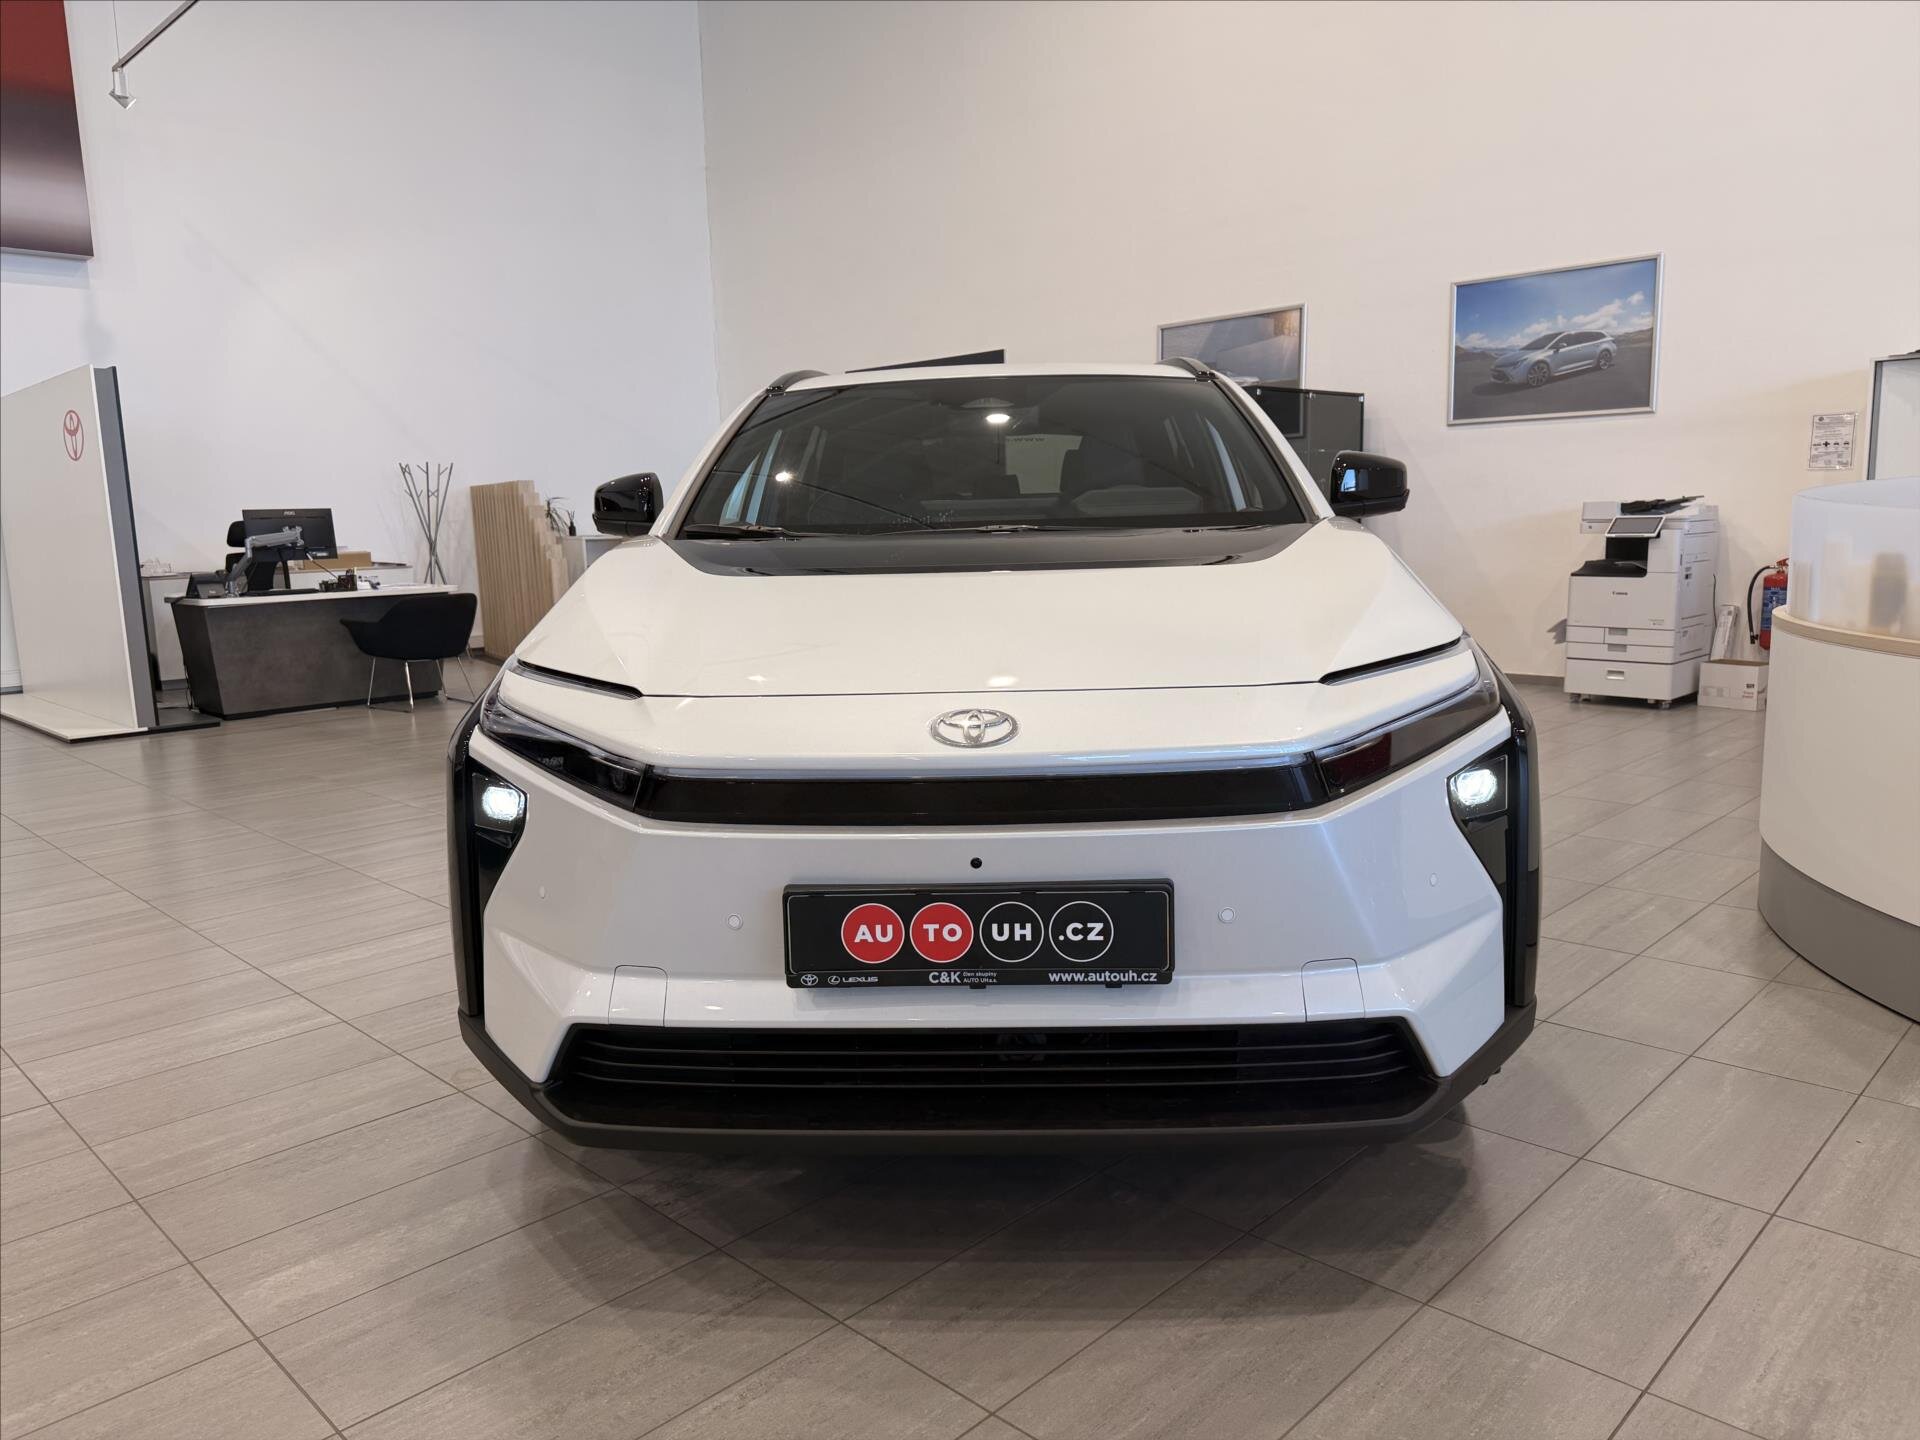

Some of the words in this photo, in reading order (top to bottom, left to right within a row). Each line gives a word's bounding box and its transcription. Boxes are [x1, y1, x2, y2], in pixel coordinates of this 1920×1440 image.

[854, 924, 893, 942] AU
[923, 923, 963, 942] TO
[991, 923, 1032, 941] UH
[1058, 922, 1104, 941] .CZ
[928, 971, 961, 984] C&K
[1048, 970, 1158, 982] www.autouh.cz
